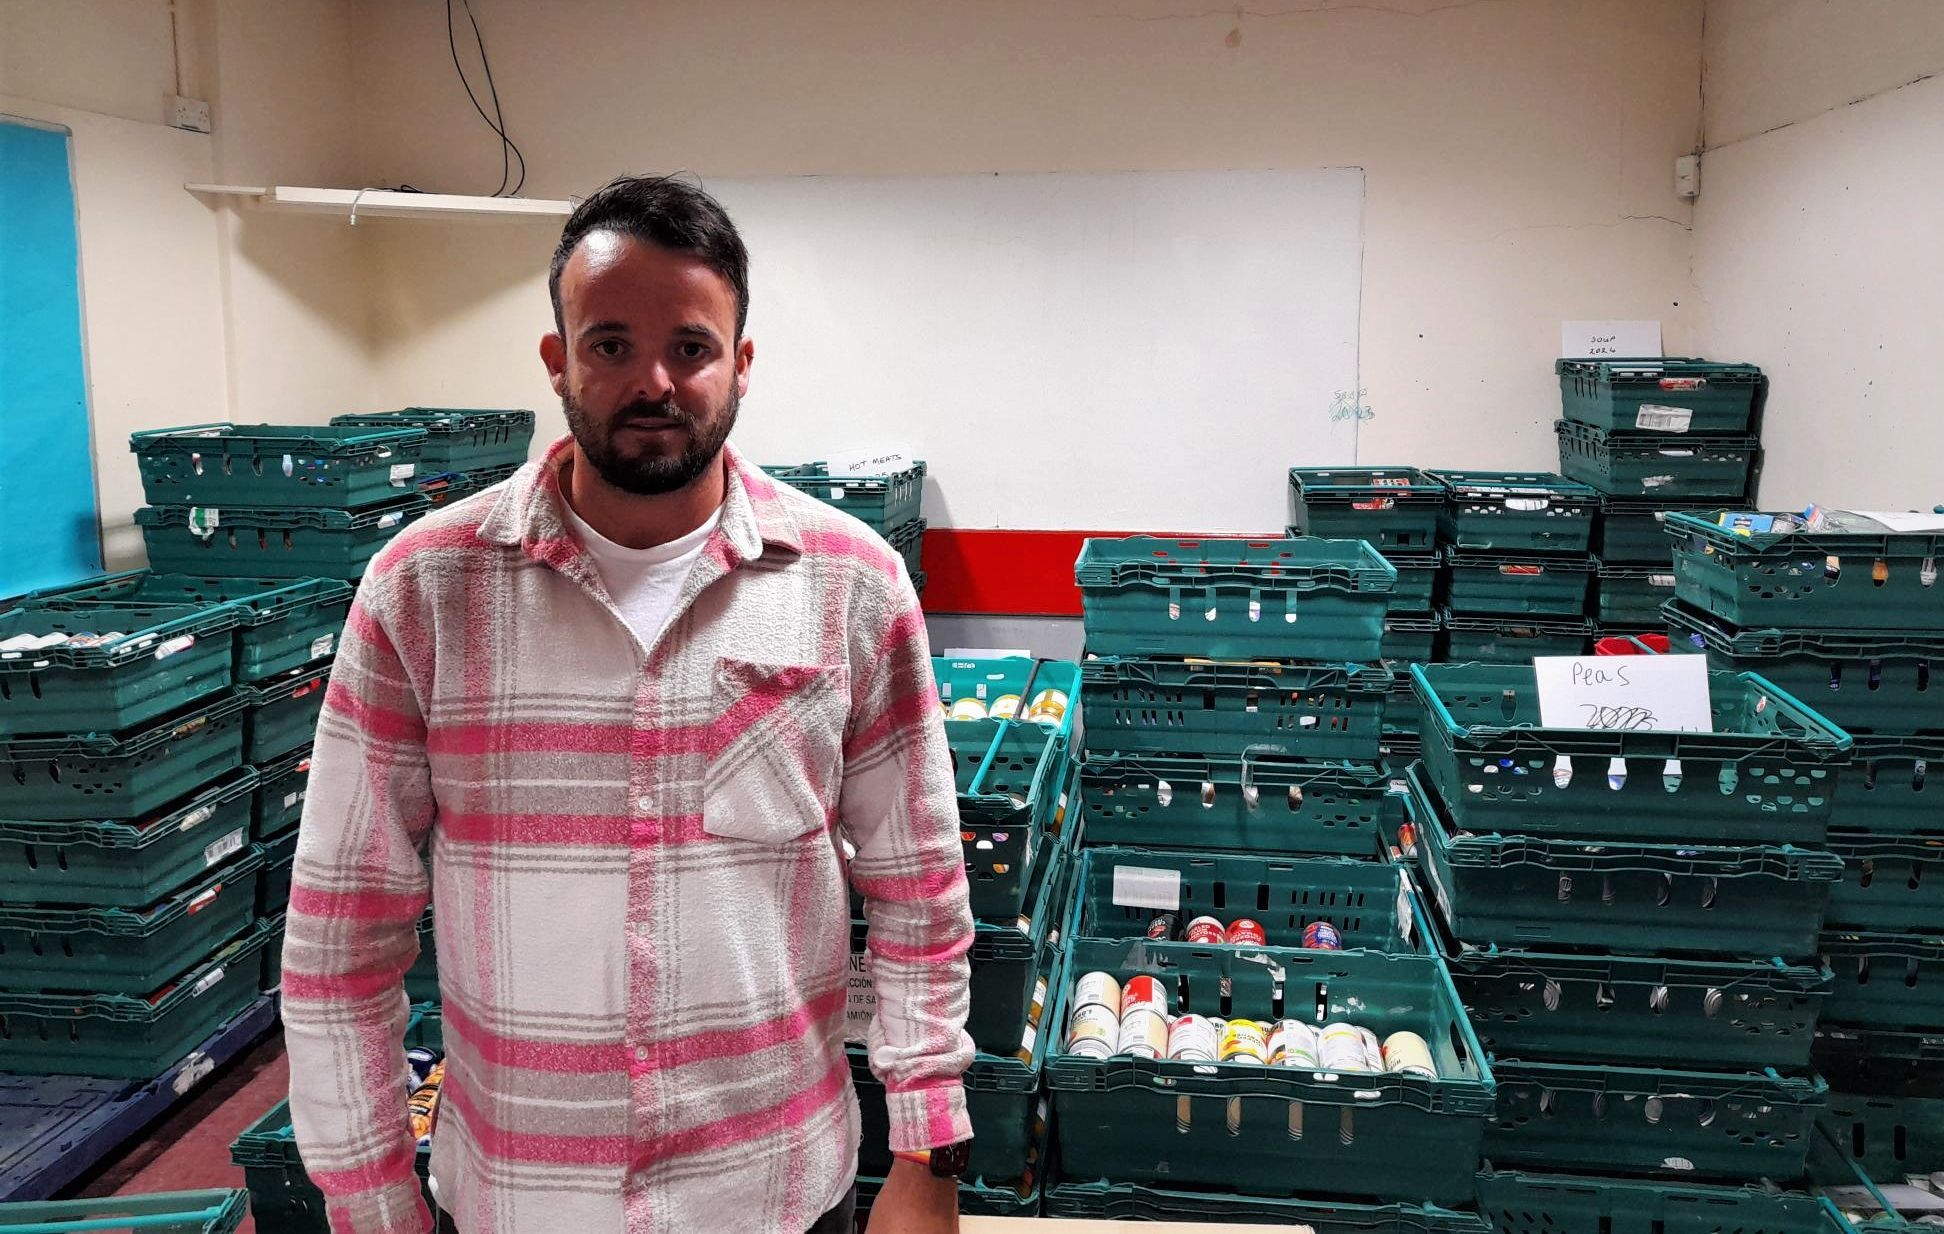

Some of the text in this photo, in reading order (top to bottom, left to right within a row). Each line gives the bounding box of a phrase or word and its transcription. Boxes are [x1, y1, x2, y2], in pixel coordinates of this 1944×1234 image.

[849, 454, 902, 471] HOT MEATS
[1572, 662, 1630, 686] Peas
[848, 976, 873, 988] CCIÓN
